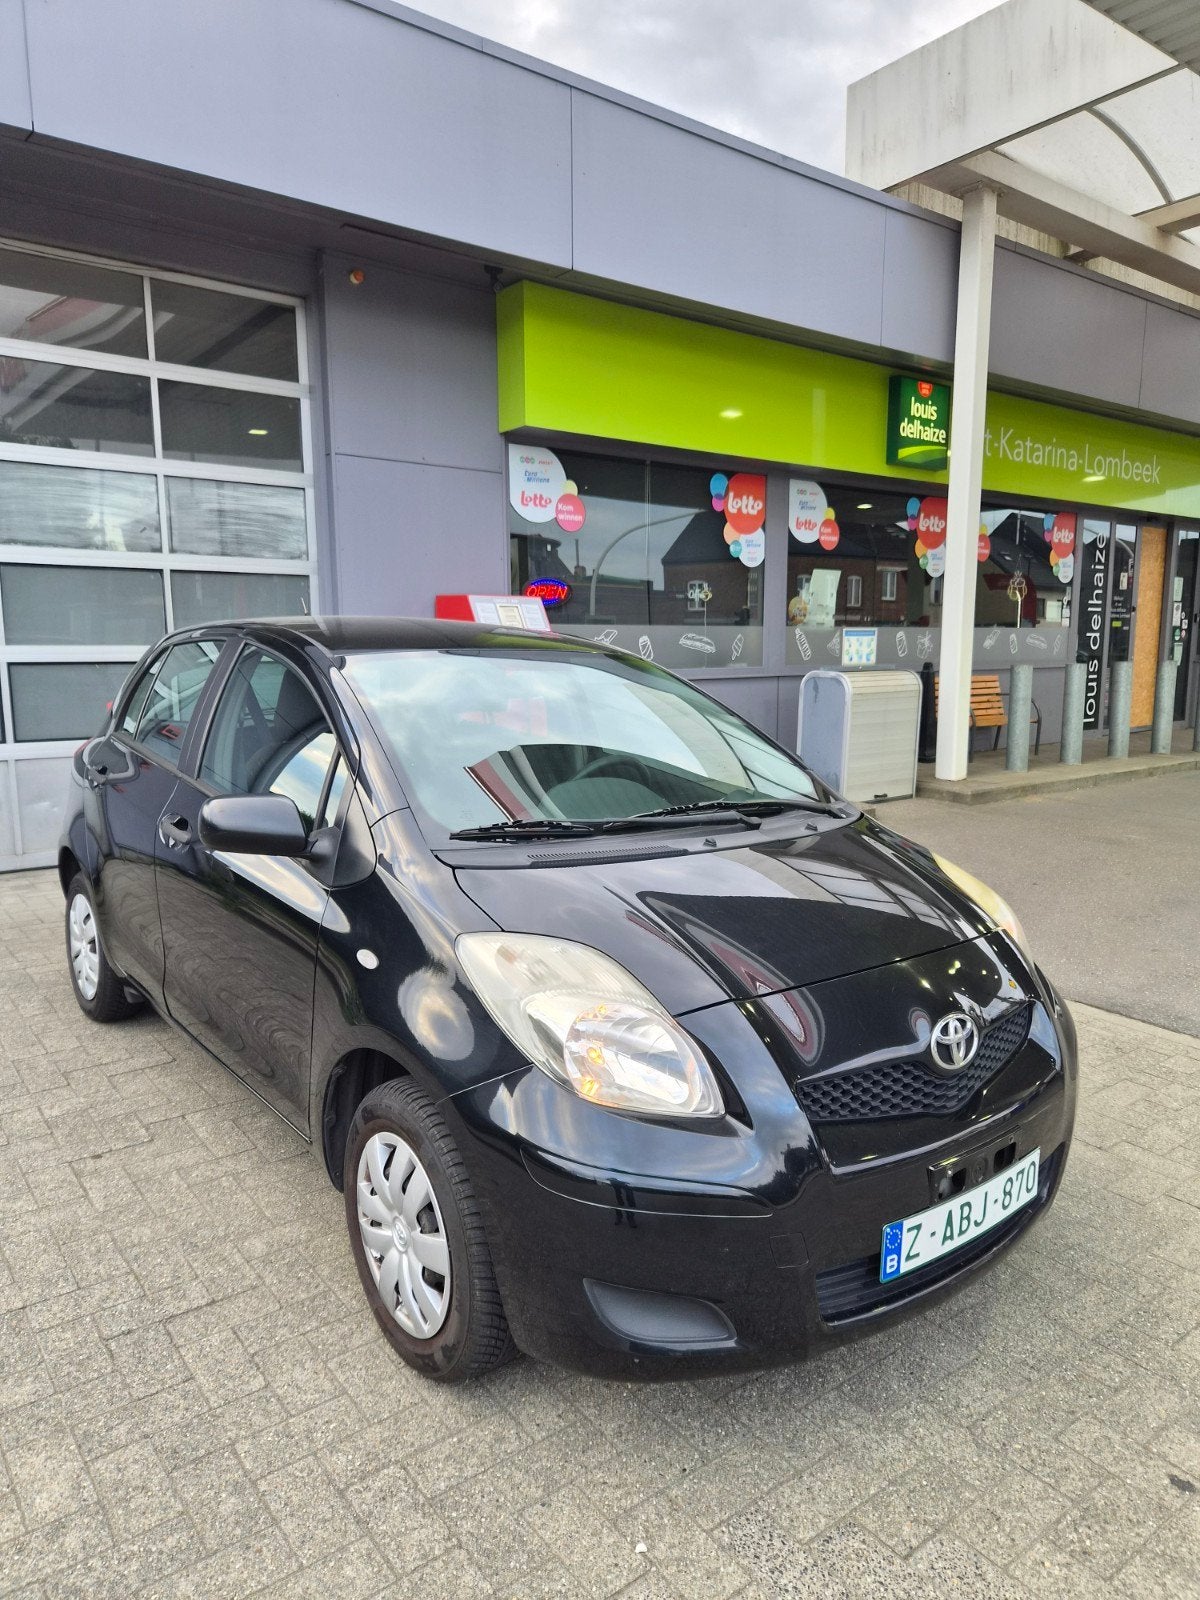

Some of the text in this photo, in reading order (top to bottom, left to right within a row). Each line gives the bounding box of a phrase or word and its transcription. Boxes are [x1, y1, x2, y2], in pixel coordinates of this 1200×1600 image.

[910, 396, 938, 421] louis
[900, 417, 947, 444] delhaize
[557, 503, 574, 512] Kom
[558, 511, 583, 521] winnen
[526, 585, 568, 600] OPEN
[1083, 532, 1107, 723] louis delhaize
[904, 1160, 1037, 1263] Z-ABJ-870
[886, 1253, 899, 1274] B
